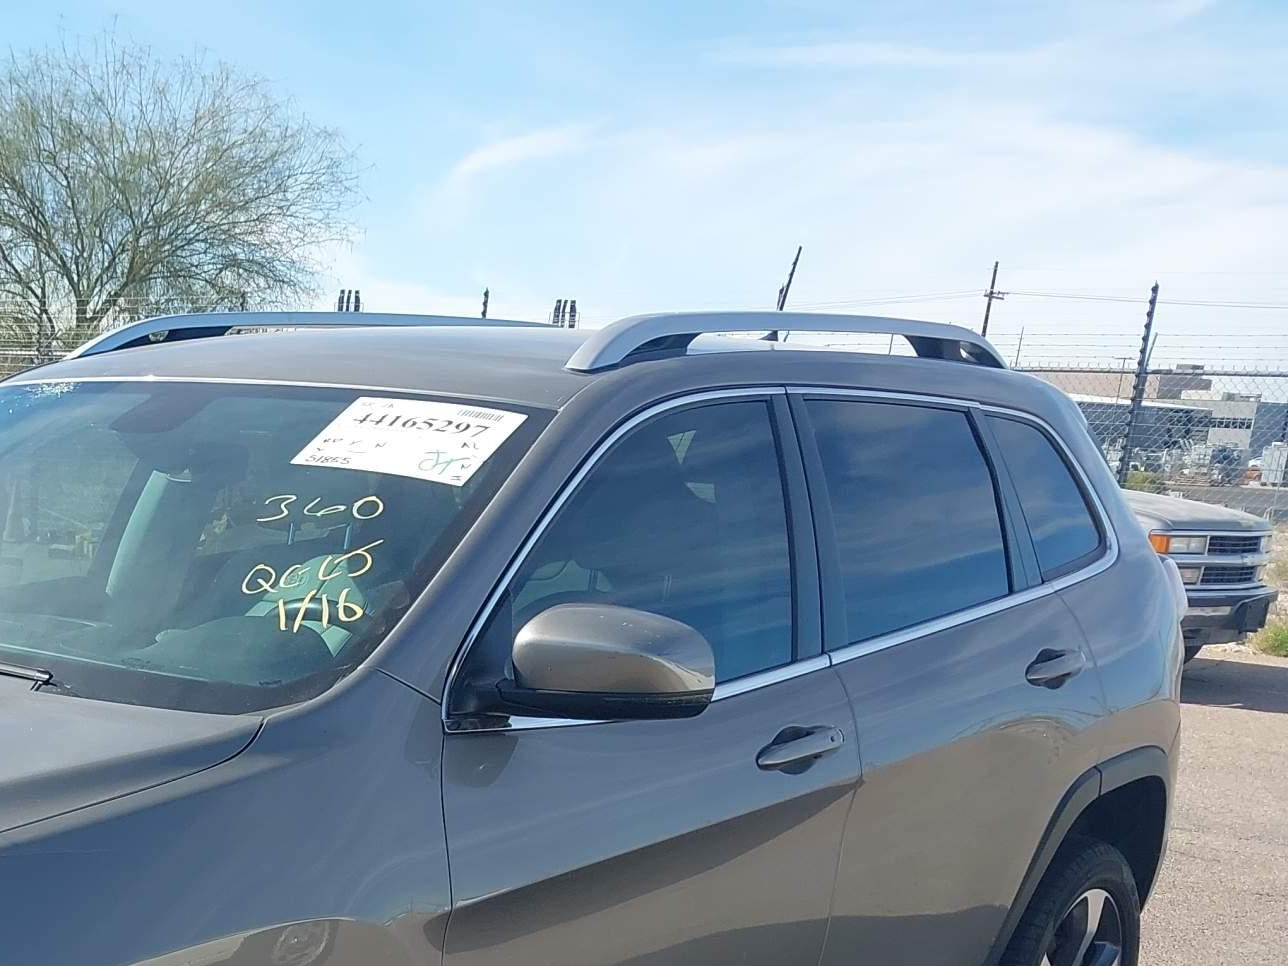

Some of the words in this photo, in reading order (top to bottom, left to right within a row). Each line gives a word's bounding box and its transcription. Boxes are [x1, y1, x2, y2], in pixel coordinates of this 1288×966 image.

[353, 412, 491, 438] 44165297
[255, 493, 385, 522] 360
[278, 587, 365, 634] 1/16
